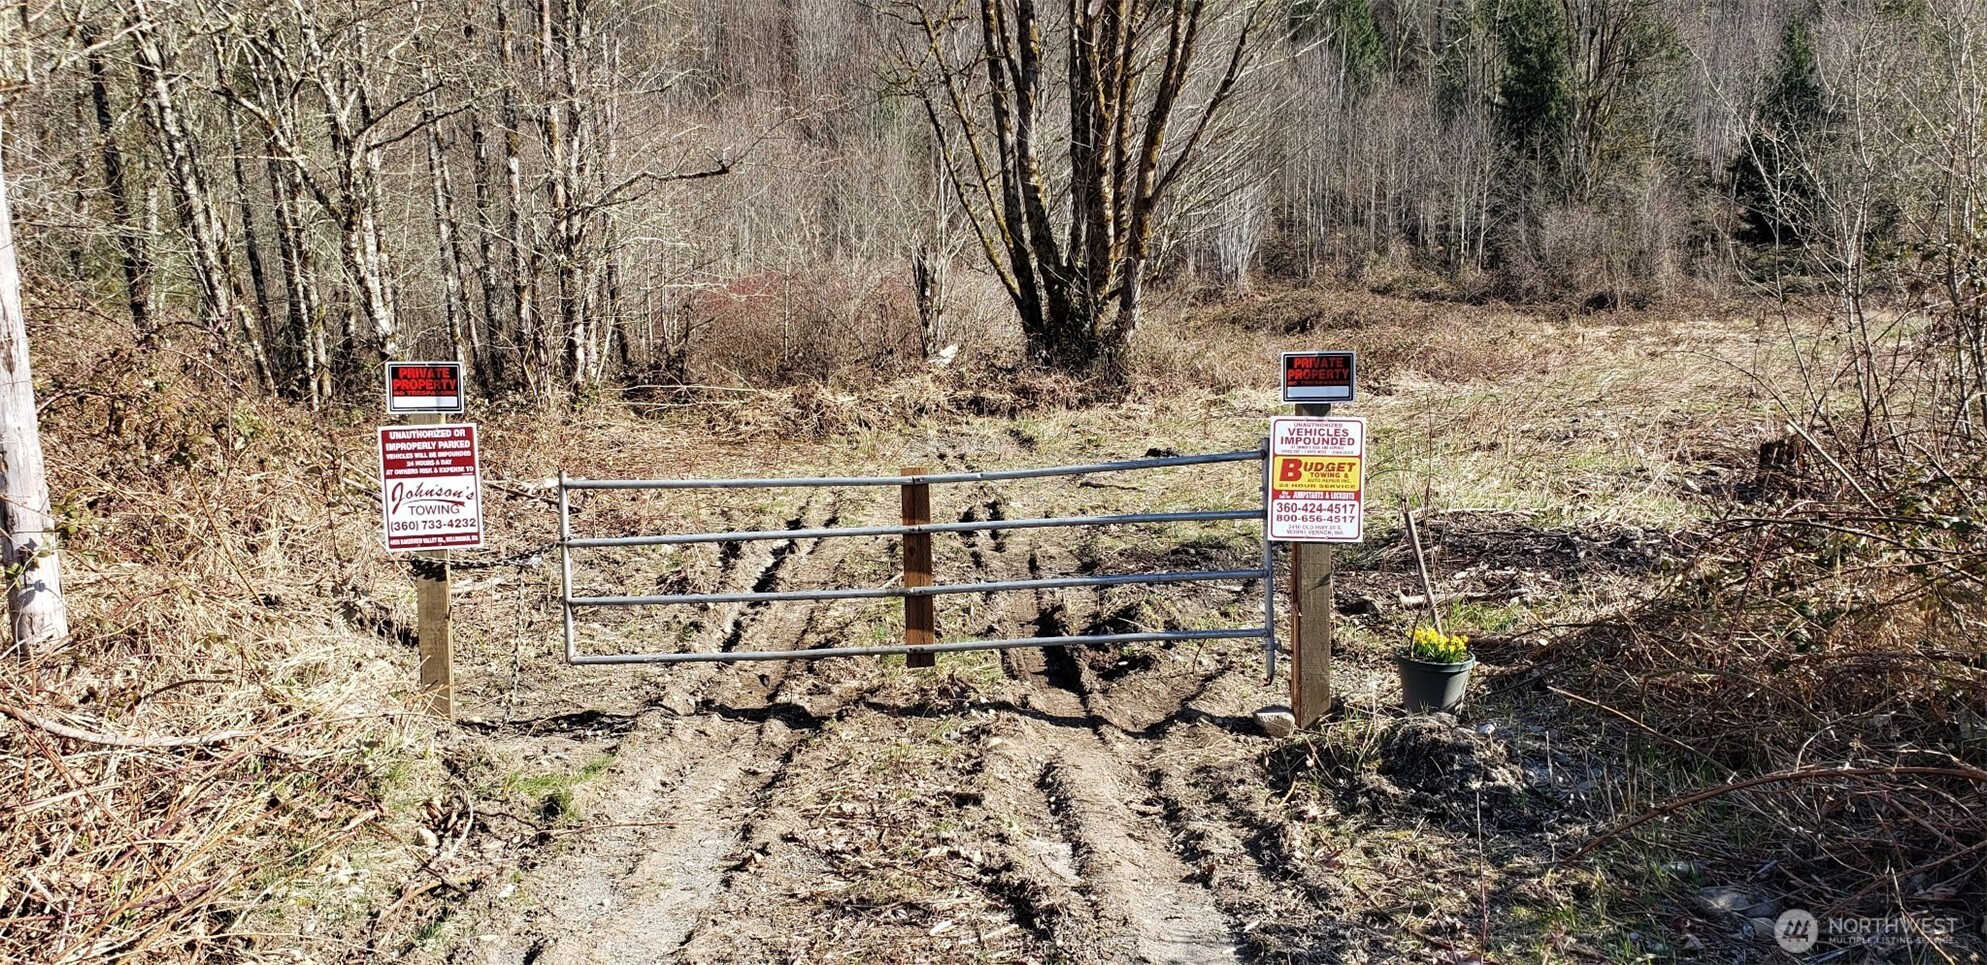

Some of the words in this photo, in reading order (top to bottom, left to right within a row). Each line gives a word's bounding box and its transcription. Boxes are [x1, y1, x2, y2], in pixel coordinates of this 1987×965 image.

[1294, 358, 1344, 368] PRIVATE
[398, 368, 450, 378] PRIVATE
[1288, 369, 1349, 379] PROPERTY
[393, 379, 456, 390] PROPERTY
[389, 429, 452, 439] UNAUTHORIZED
[453, 429, 465, 437] OR
[1288, 428, 1349, 437] VEHICLES
[385, 442, 437, 451] IMPROPERLY
[438, 440, 470, 448] PARKED
[1280, 436, 1355, 446] IMPOUNDED
[1279, 459, 1356, 481] BUDGET
[391, 482, 474, 515] Johnson's
[408, 505, 460, 515] TOWING
[1276, 503, 1355, 514] 360-424-4517
[1276, 515, 1355, 523] 800-656-4517
[390, 521, 419, 532] (360)
[422, 518, 476, 530] 733-4232
